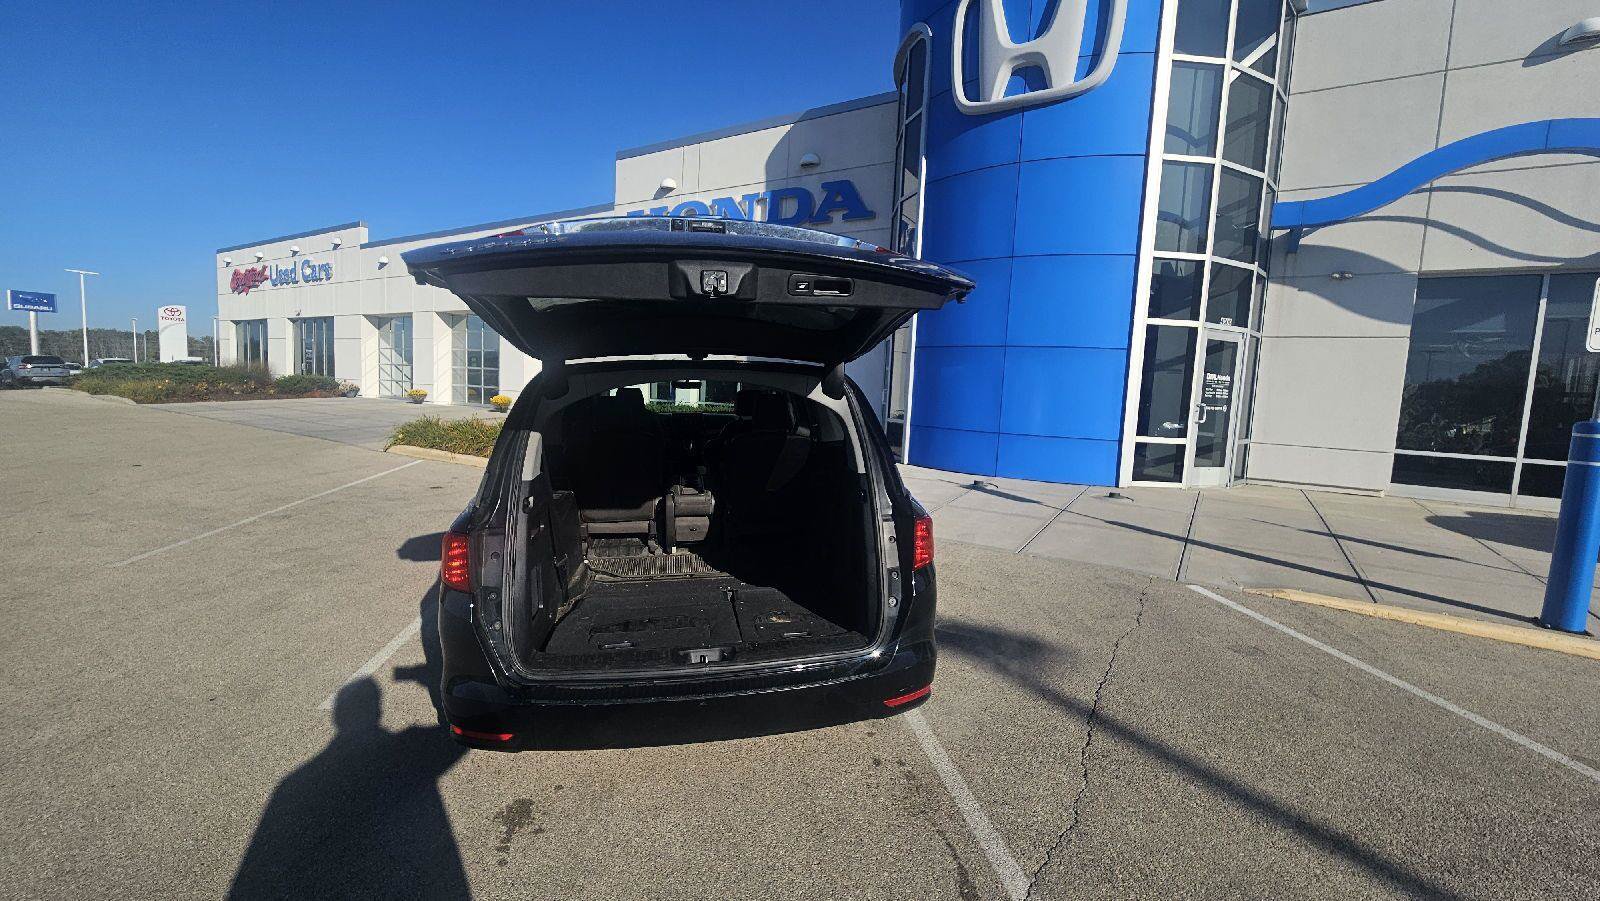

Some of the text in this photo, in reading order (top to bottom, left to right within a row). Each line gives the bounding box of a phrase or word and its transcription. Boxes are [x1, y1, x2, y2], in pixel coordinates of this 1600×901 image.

[626, 180, 876, 226] NDA
[269, 261, 299, 287] Used
[301, 259, 333, 283] Cars
[13, 303, 53, 311] SUBARU
